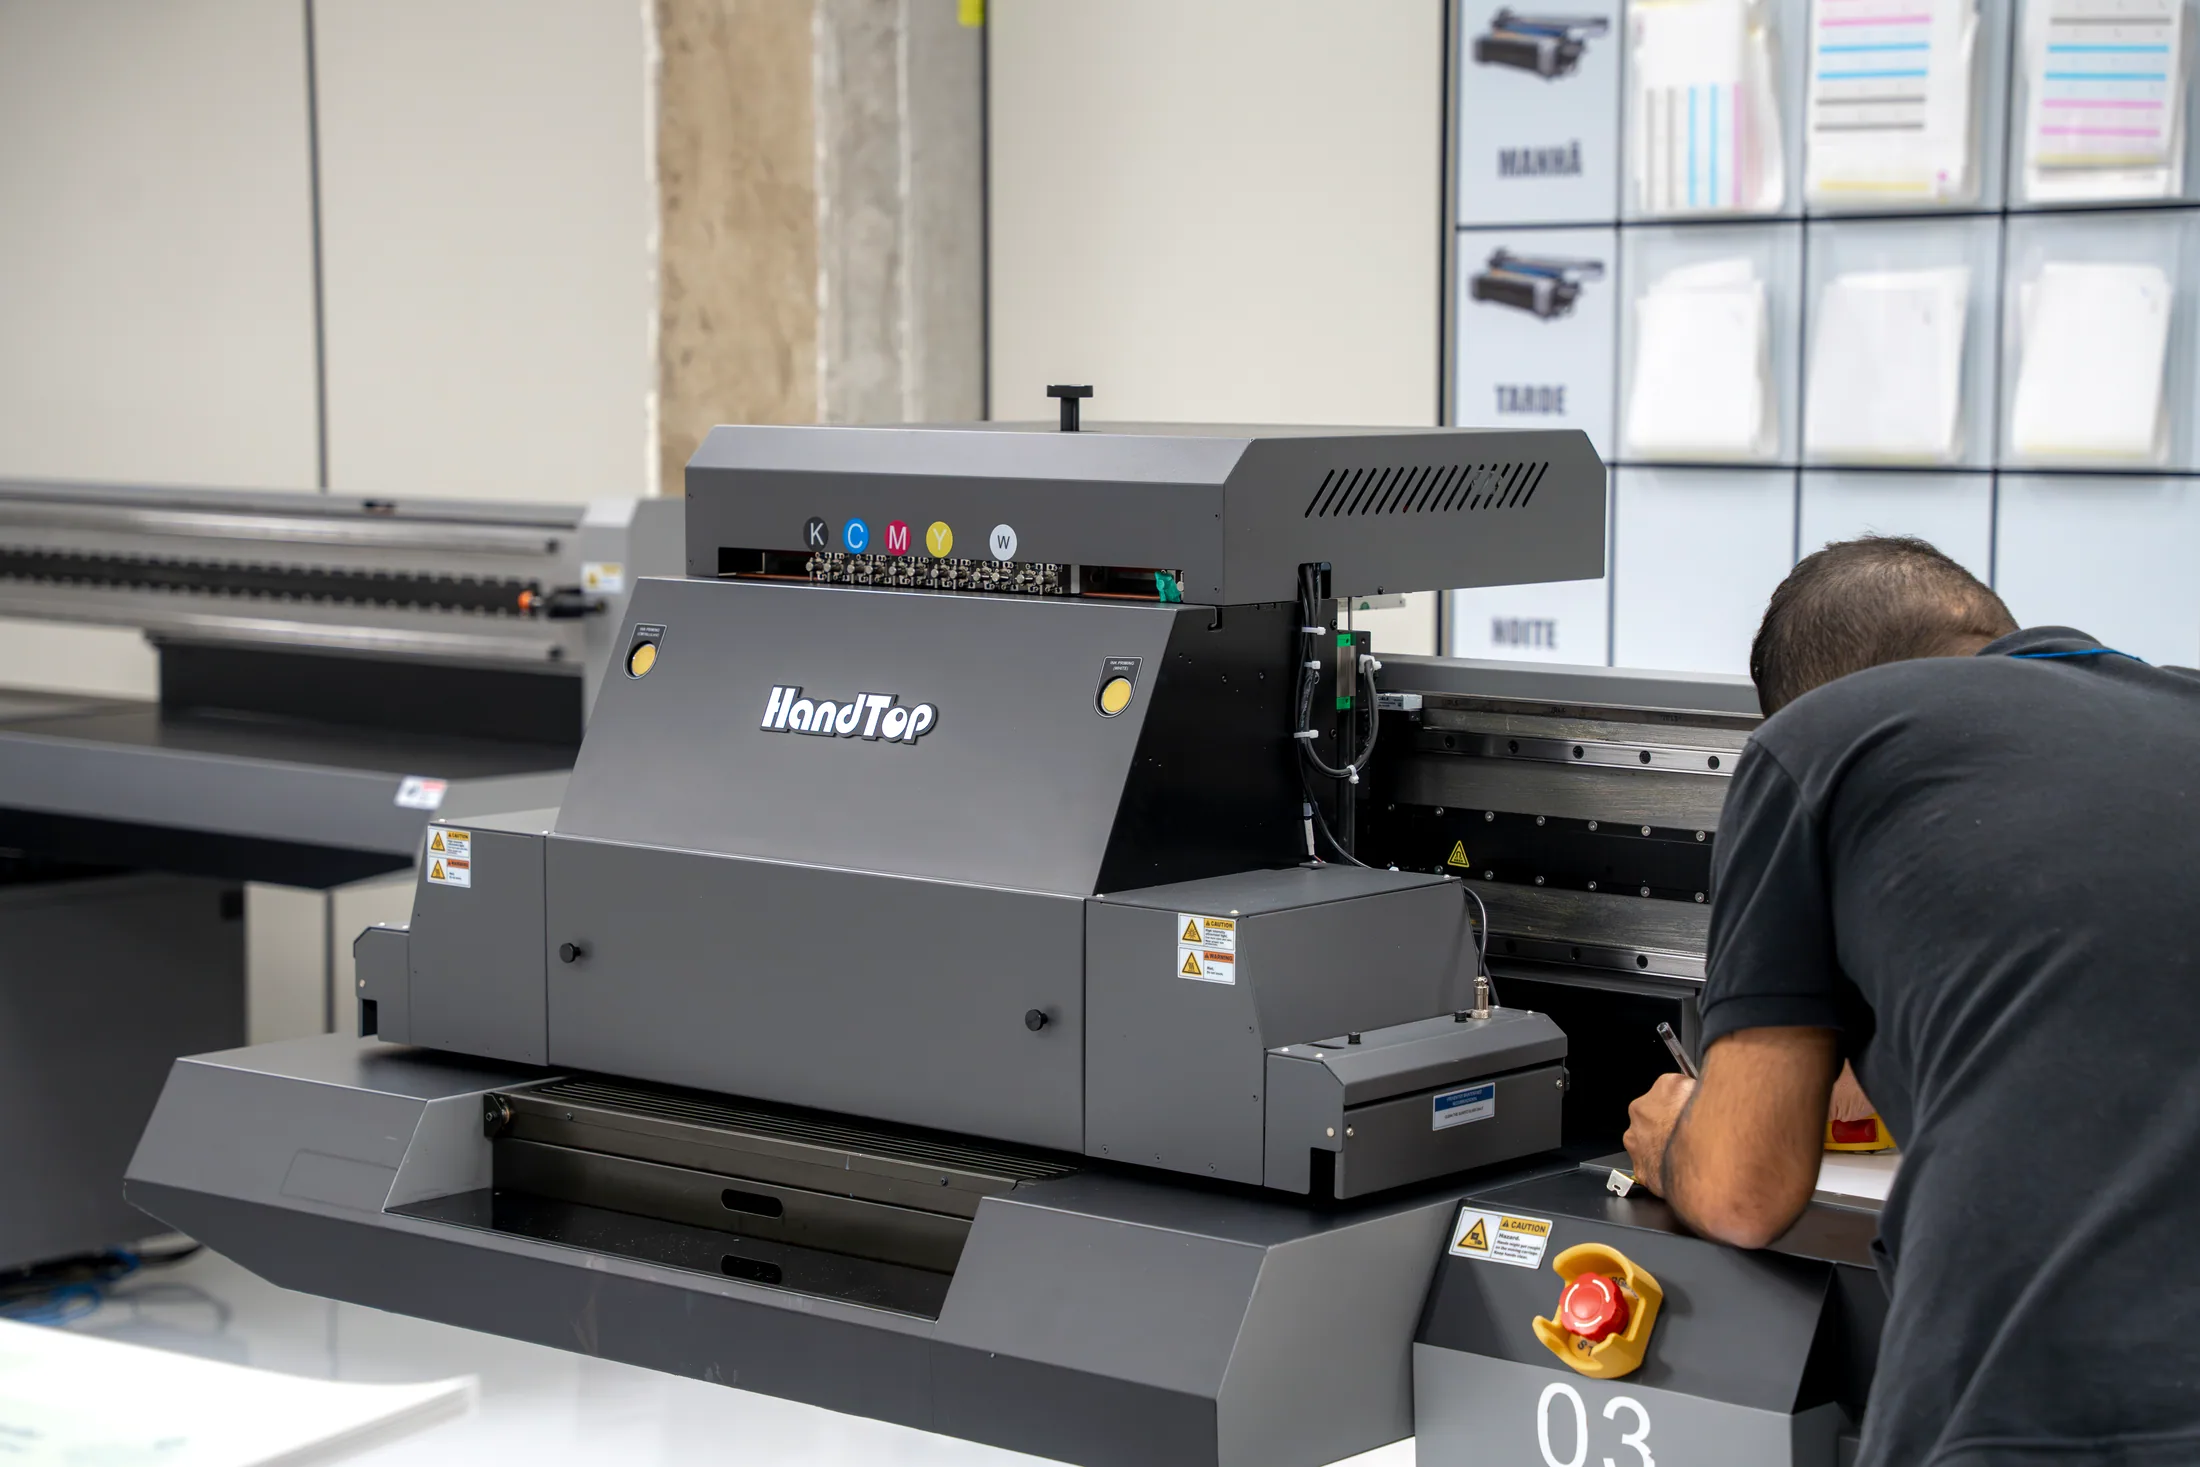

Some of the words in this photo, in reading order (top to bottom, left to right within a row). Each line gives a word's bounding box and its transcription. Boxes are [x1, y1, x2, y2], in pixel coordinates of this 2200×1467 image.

[1495, 383, 1568, 416] TARDE
[810, 522, 825, 546] K
[847, 523, 864, 549] C
[888, 525, 907, 551] M
[932, 528, 947, 551] Y
[997, 534, 1010, 550] W
[1490, 616, 1557, 651] NOITE
[760, 686, 933, 741] HandTop
[1498, 1232, 1520, 1241] Hazard.
[1511, 1221, 1546, 1233] CAUTION
[1537, 1382, 1655, 1467] 03
